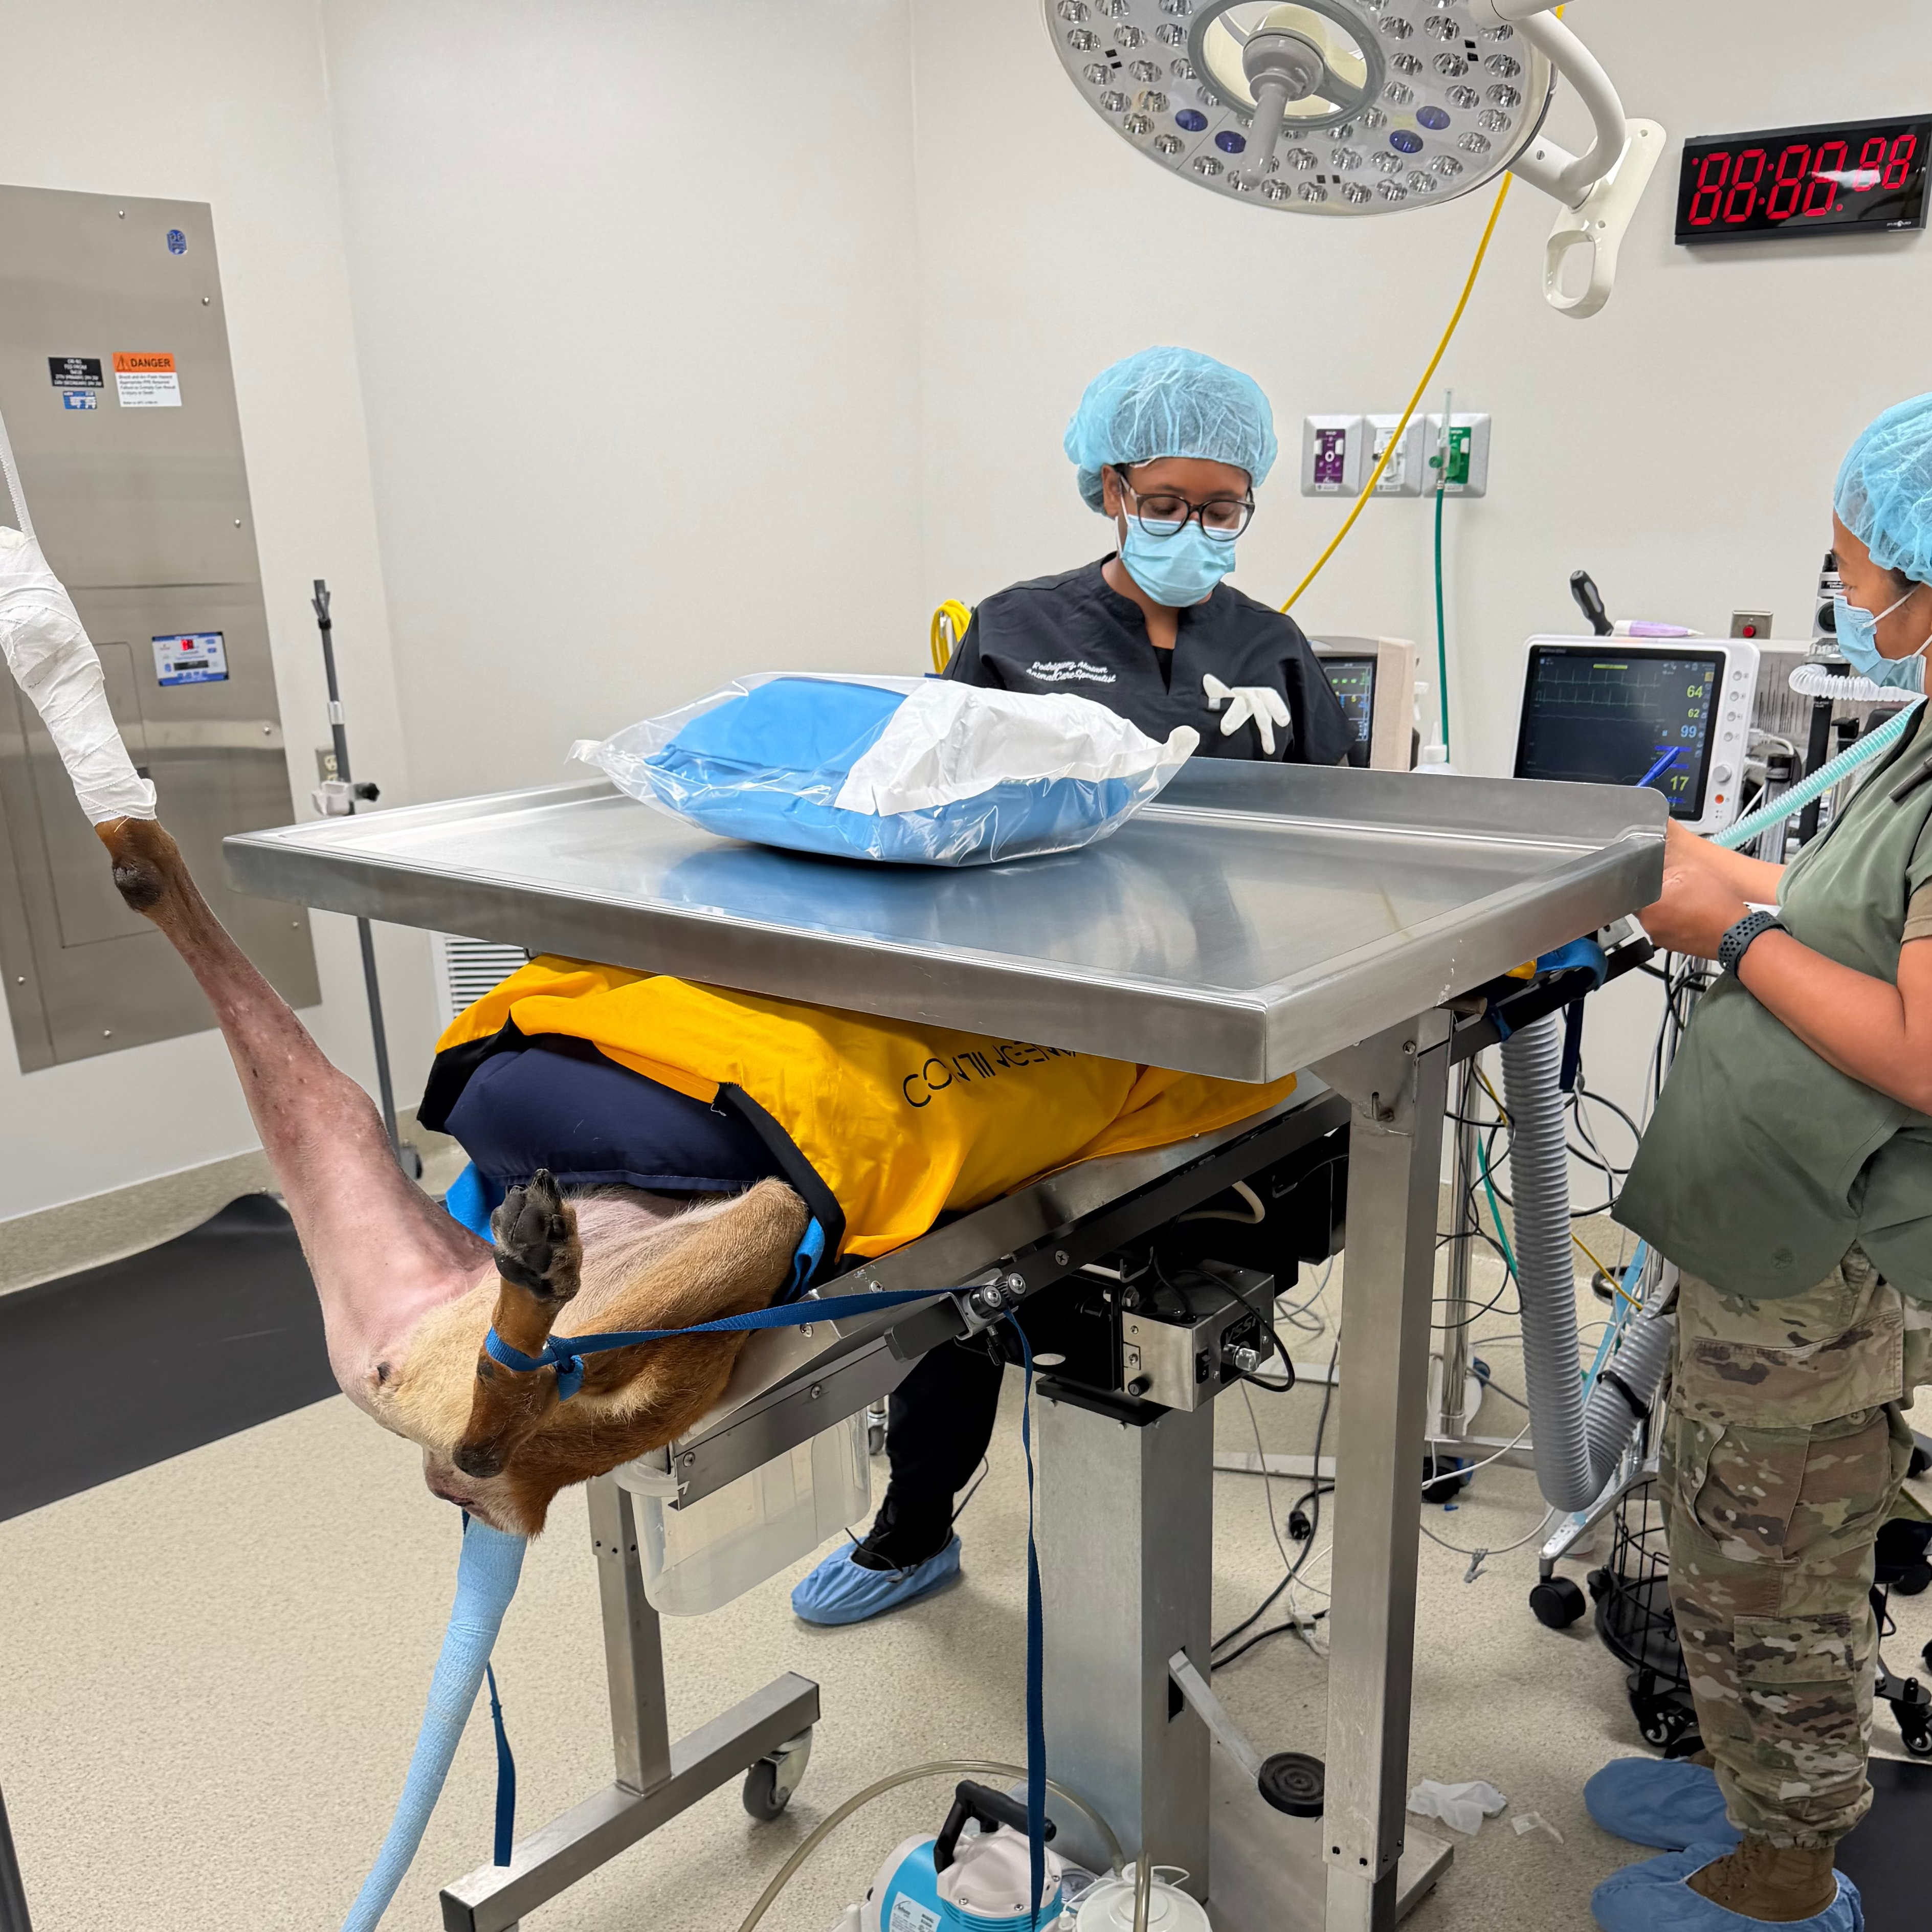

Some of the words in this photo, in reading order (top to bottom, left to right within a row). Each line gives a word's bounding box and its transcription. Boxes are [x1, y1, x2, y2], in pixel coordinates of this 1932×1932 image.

[130, 358, 171, 367] DANGER
[1686, 684, 1703, 699] 64
[1687, 708, 1700, 719] 62
[1680, 724, 1697, 739] 99
[1670, 775, 1690, 792] 17
